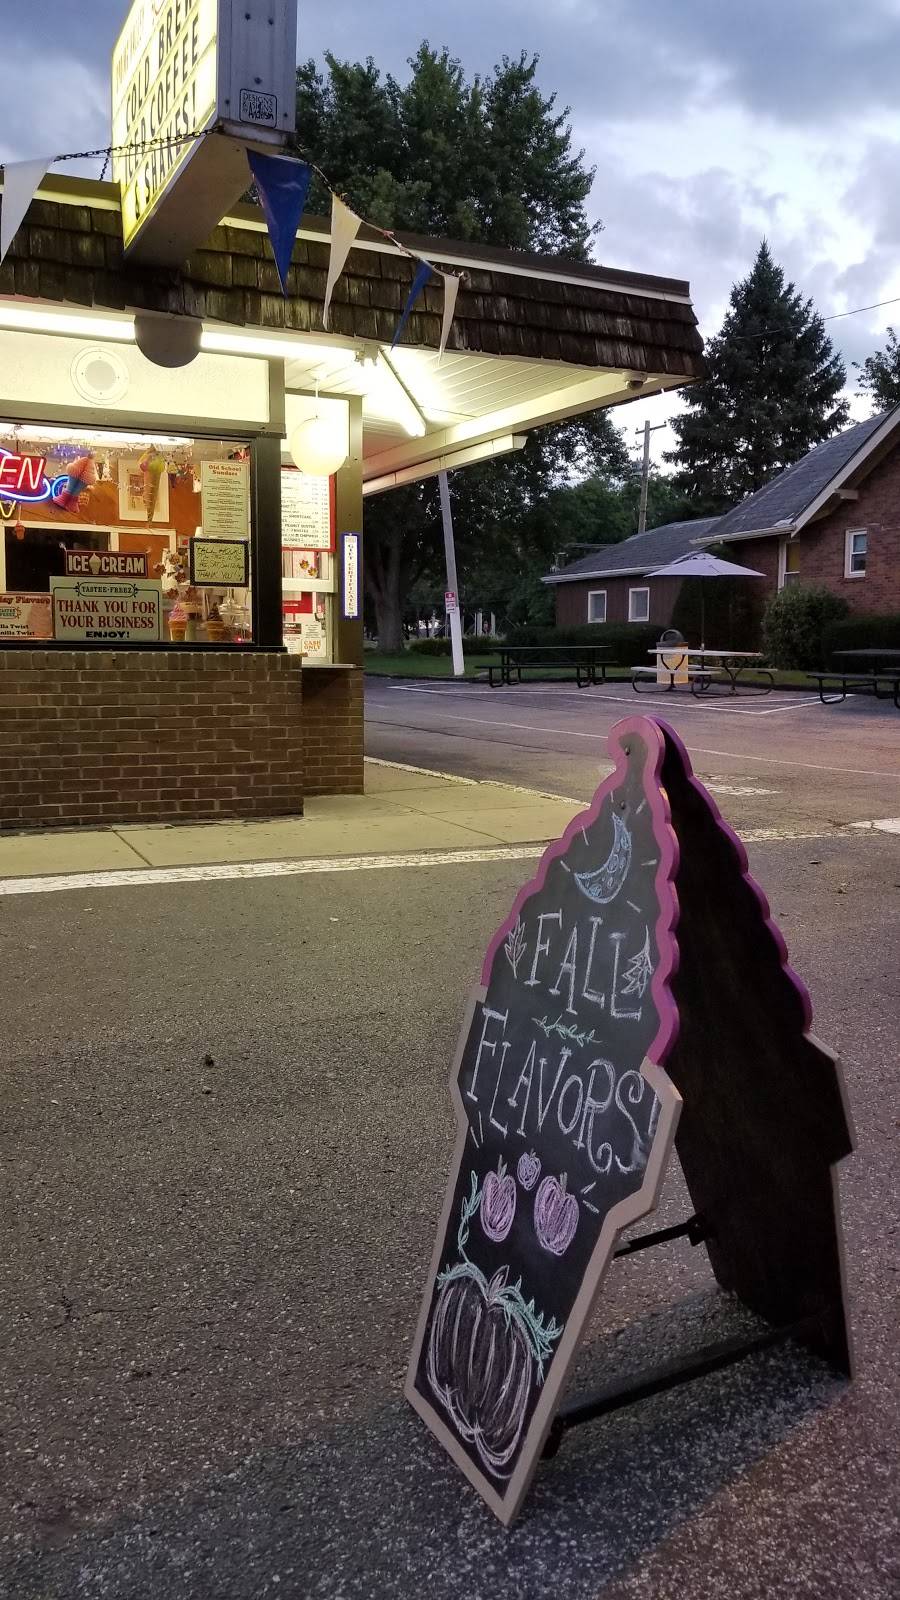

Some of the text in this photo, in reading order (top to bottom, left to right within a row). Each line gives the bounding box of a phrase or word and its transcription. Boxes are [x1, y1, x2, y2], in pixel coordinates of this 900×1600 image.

[124, 117, 147, 186] ICED
[150, 16, 199, 138] COFFEE
[126, 55, 149, 132] COLD
[243, 92, 276, 109] DESIGNS
[144, 82, 197, 204] SHAKES!
[68, 555, 145, 574] ICE CREAM
[16, 596, 51, 605] Flavors
[57, 599, 156, 614] THANK YOU FOR
[60, 615, 154, 629] YOUR BUSINESS
[86, 630, 130, 639] ENJOY!
[523, 908, 643, 1022] FALL
